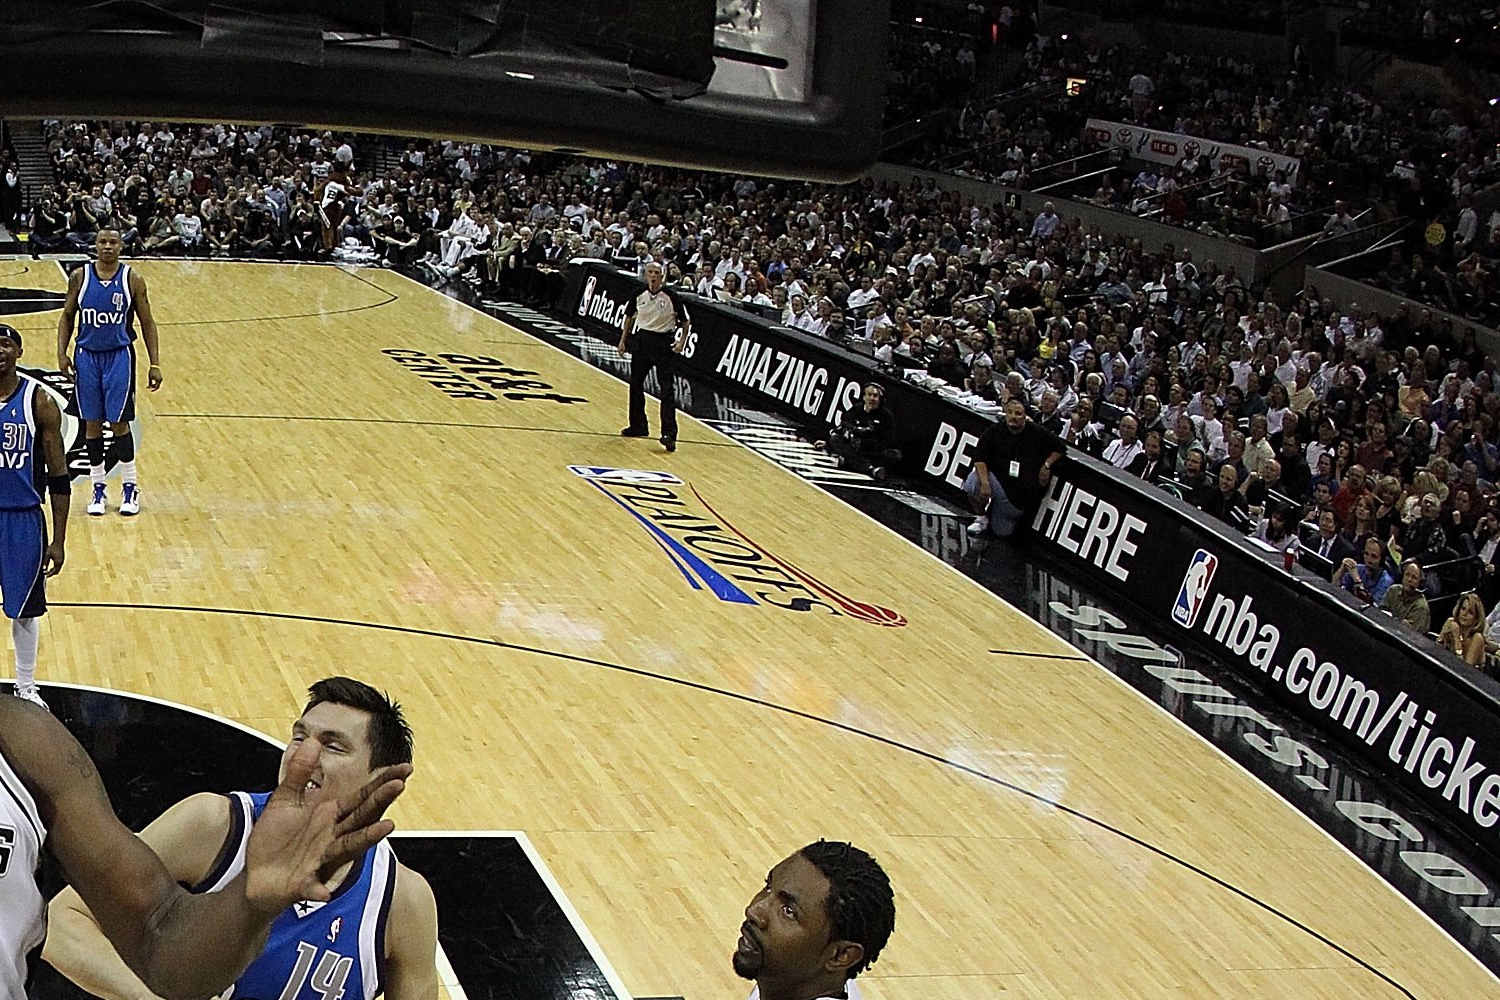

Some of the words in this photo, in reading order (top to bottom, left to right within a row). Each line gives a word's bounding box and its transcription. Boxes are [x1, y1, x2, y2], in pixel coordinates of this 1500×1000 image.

[381, 349, 498, 401] CENTER
[437, 353, 589, 404] at&t
[716, 334, 828, 416] AMAZING
[826, 377, 861, 426] IS
[2, 422, 28, 450] 31
[603, 480, 844, 616] PLAYOFFS
[1032, 476, 1148, 582] HERE
